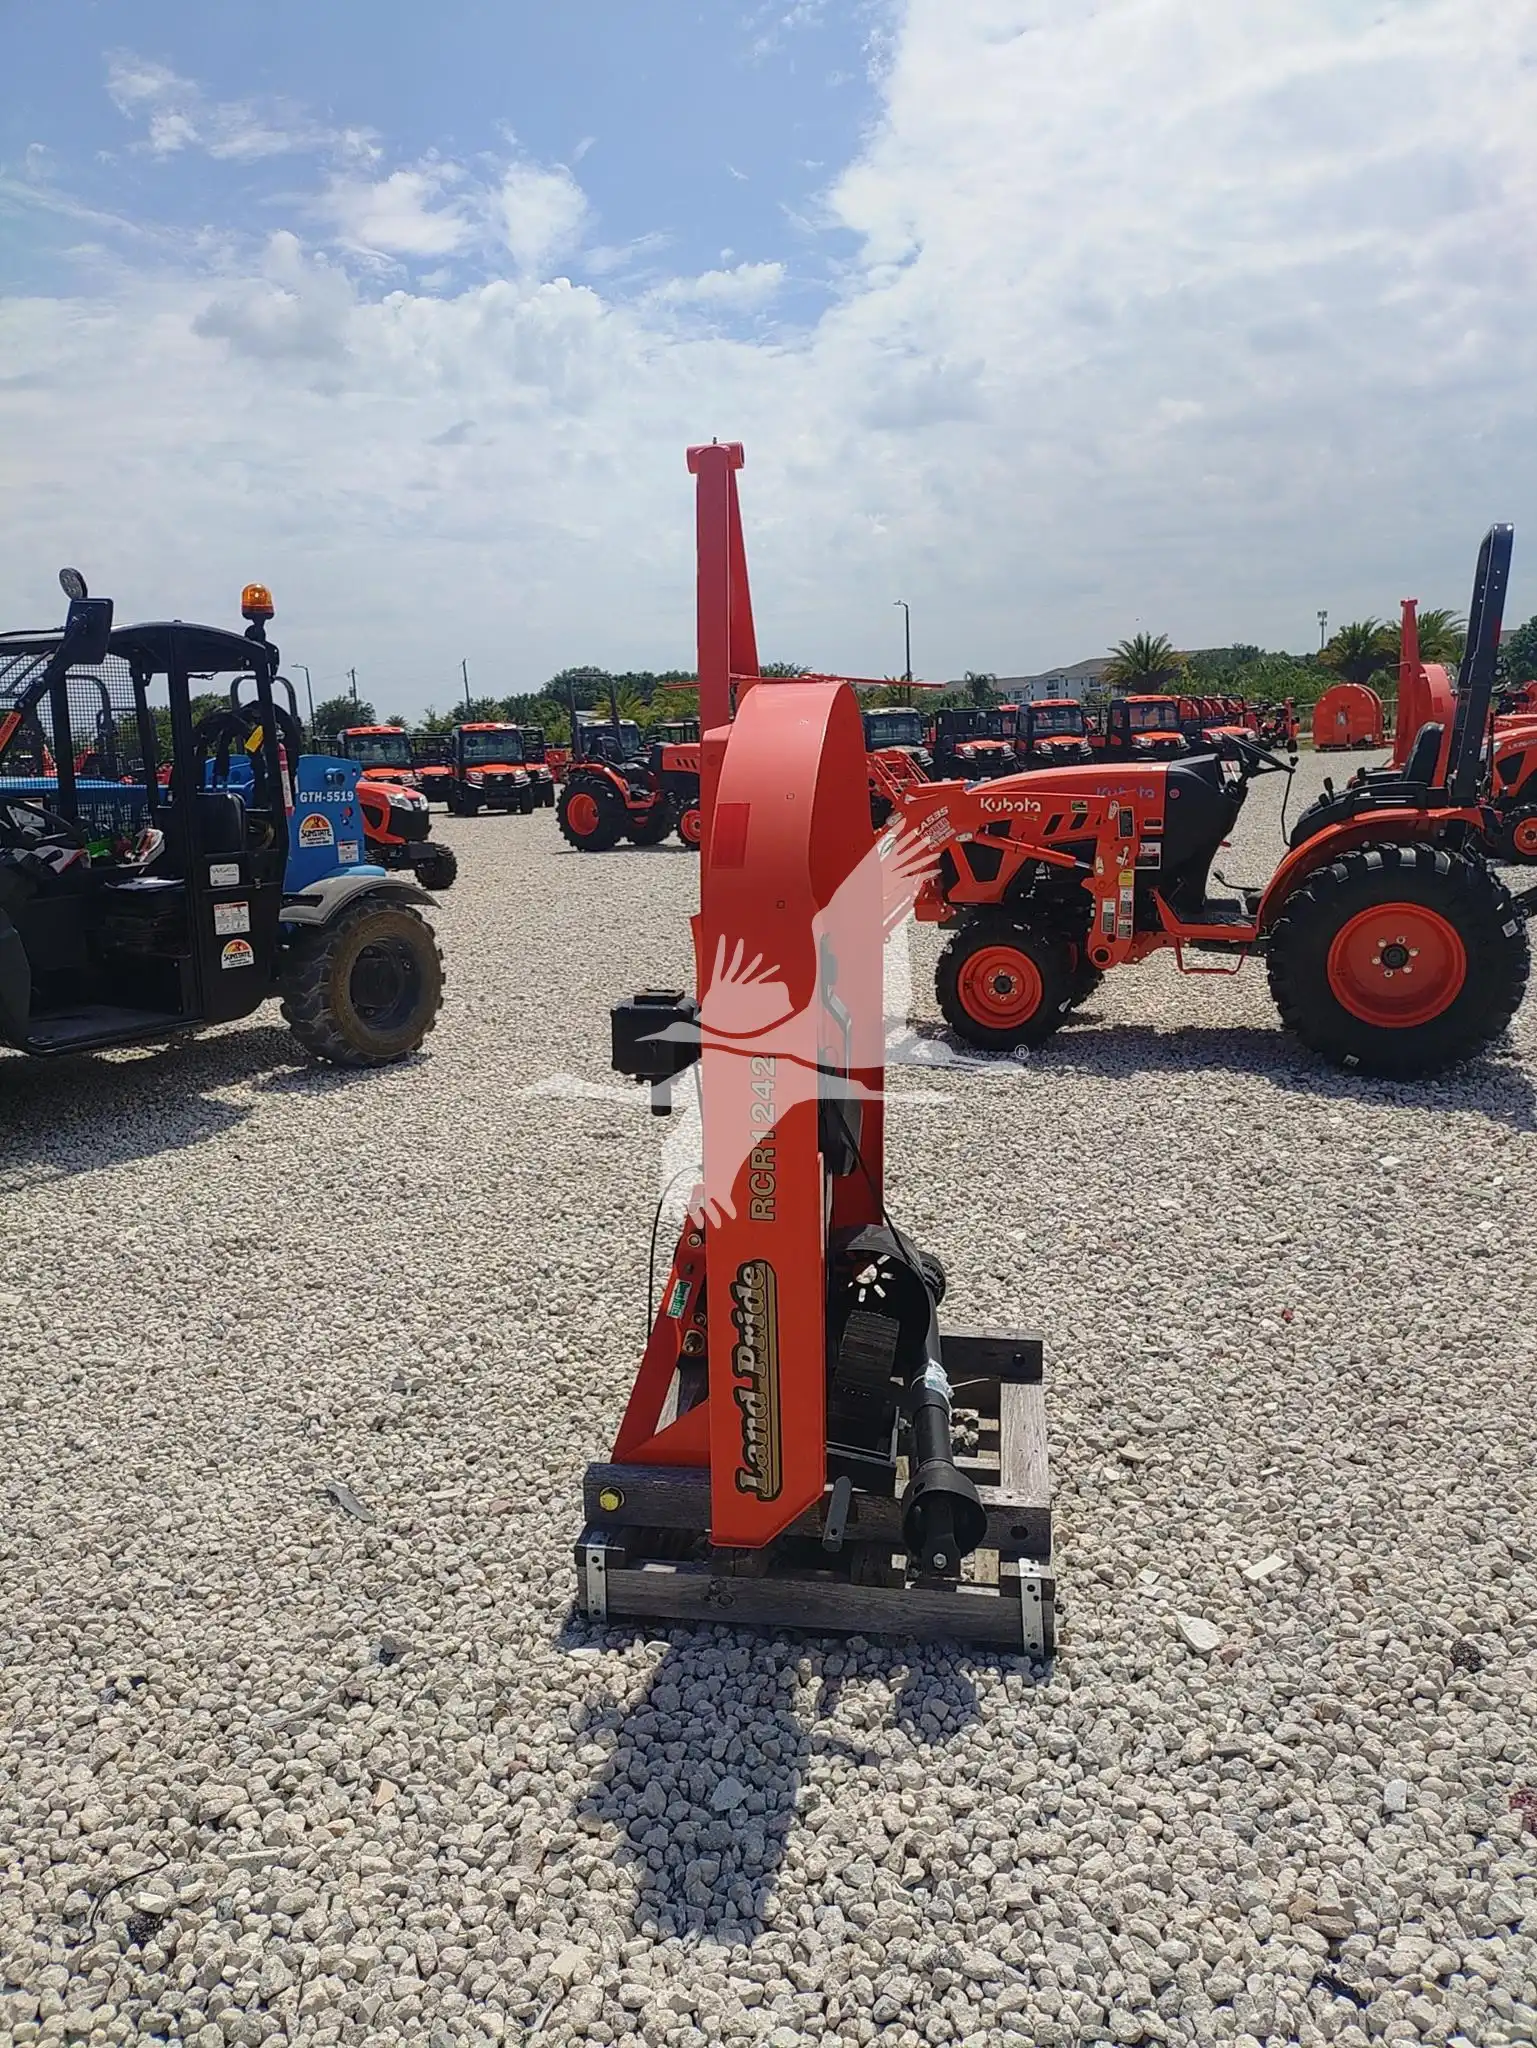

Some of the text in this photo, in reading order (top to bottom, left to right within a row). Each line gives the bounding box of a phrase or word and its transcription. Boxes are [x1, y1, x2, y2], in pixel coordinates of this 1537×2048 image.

[299, 790, 355, 803] GTH-5519
[980, 797, 1041, 813] Kubota
[750, 1054, 776, 1222] RCR1242
[735, 1261, 769, 1495] Land Pride
